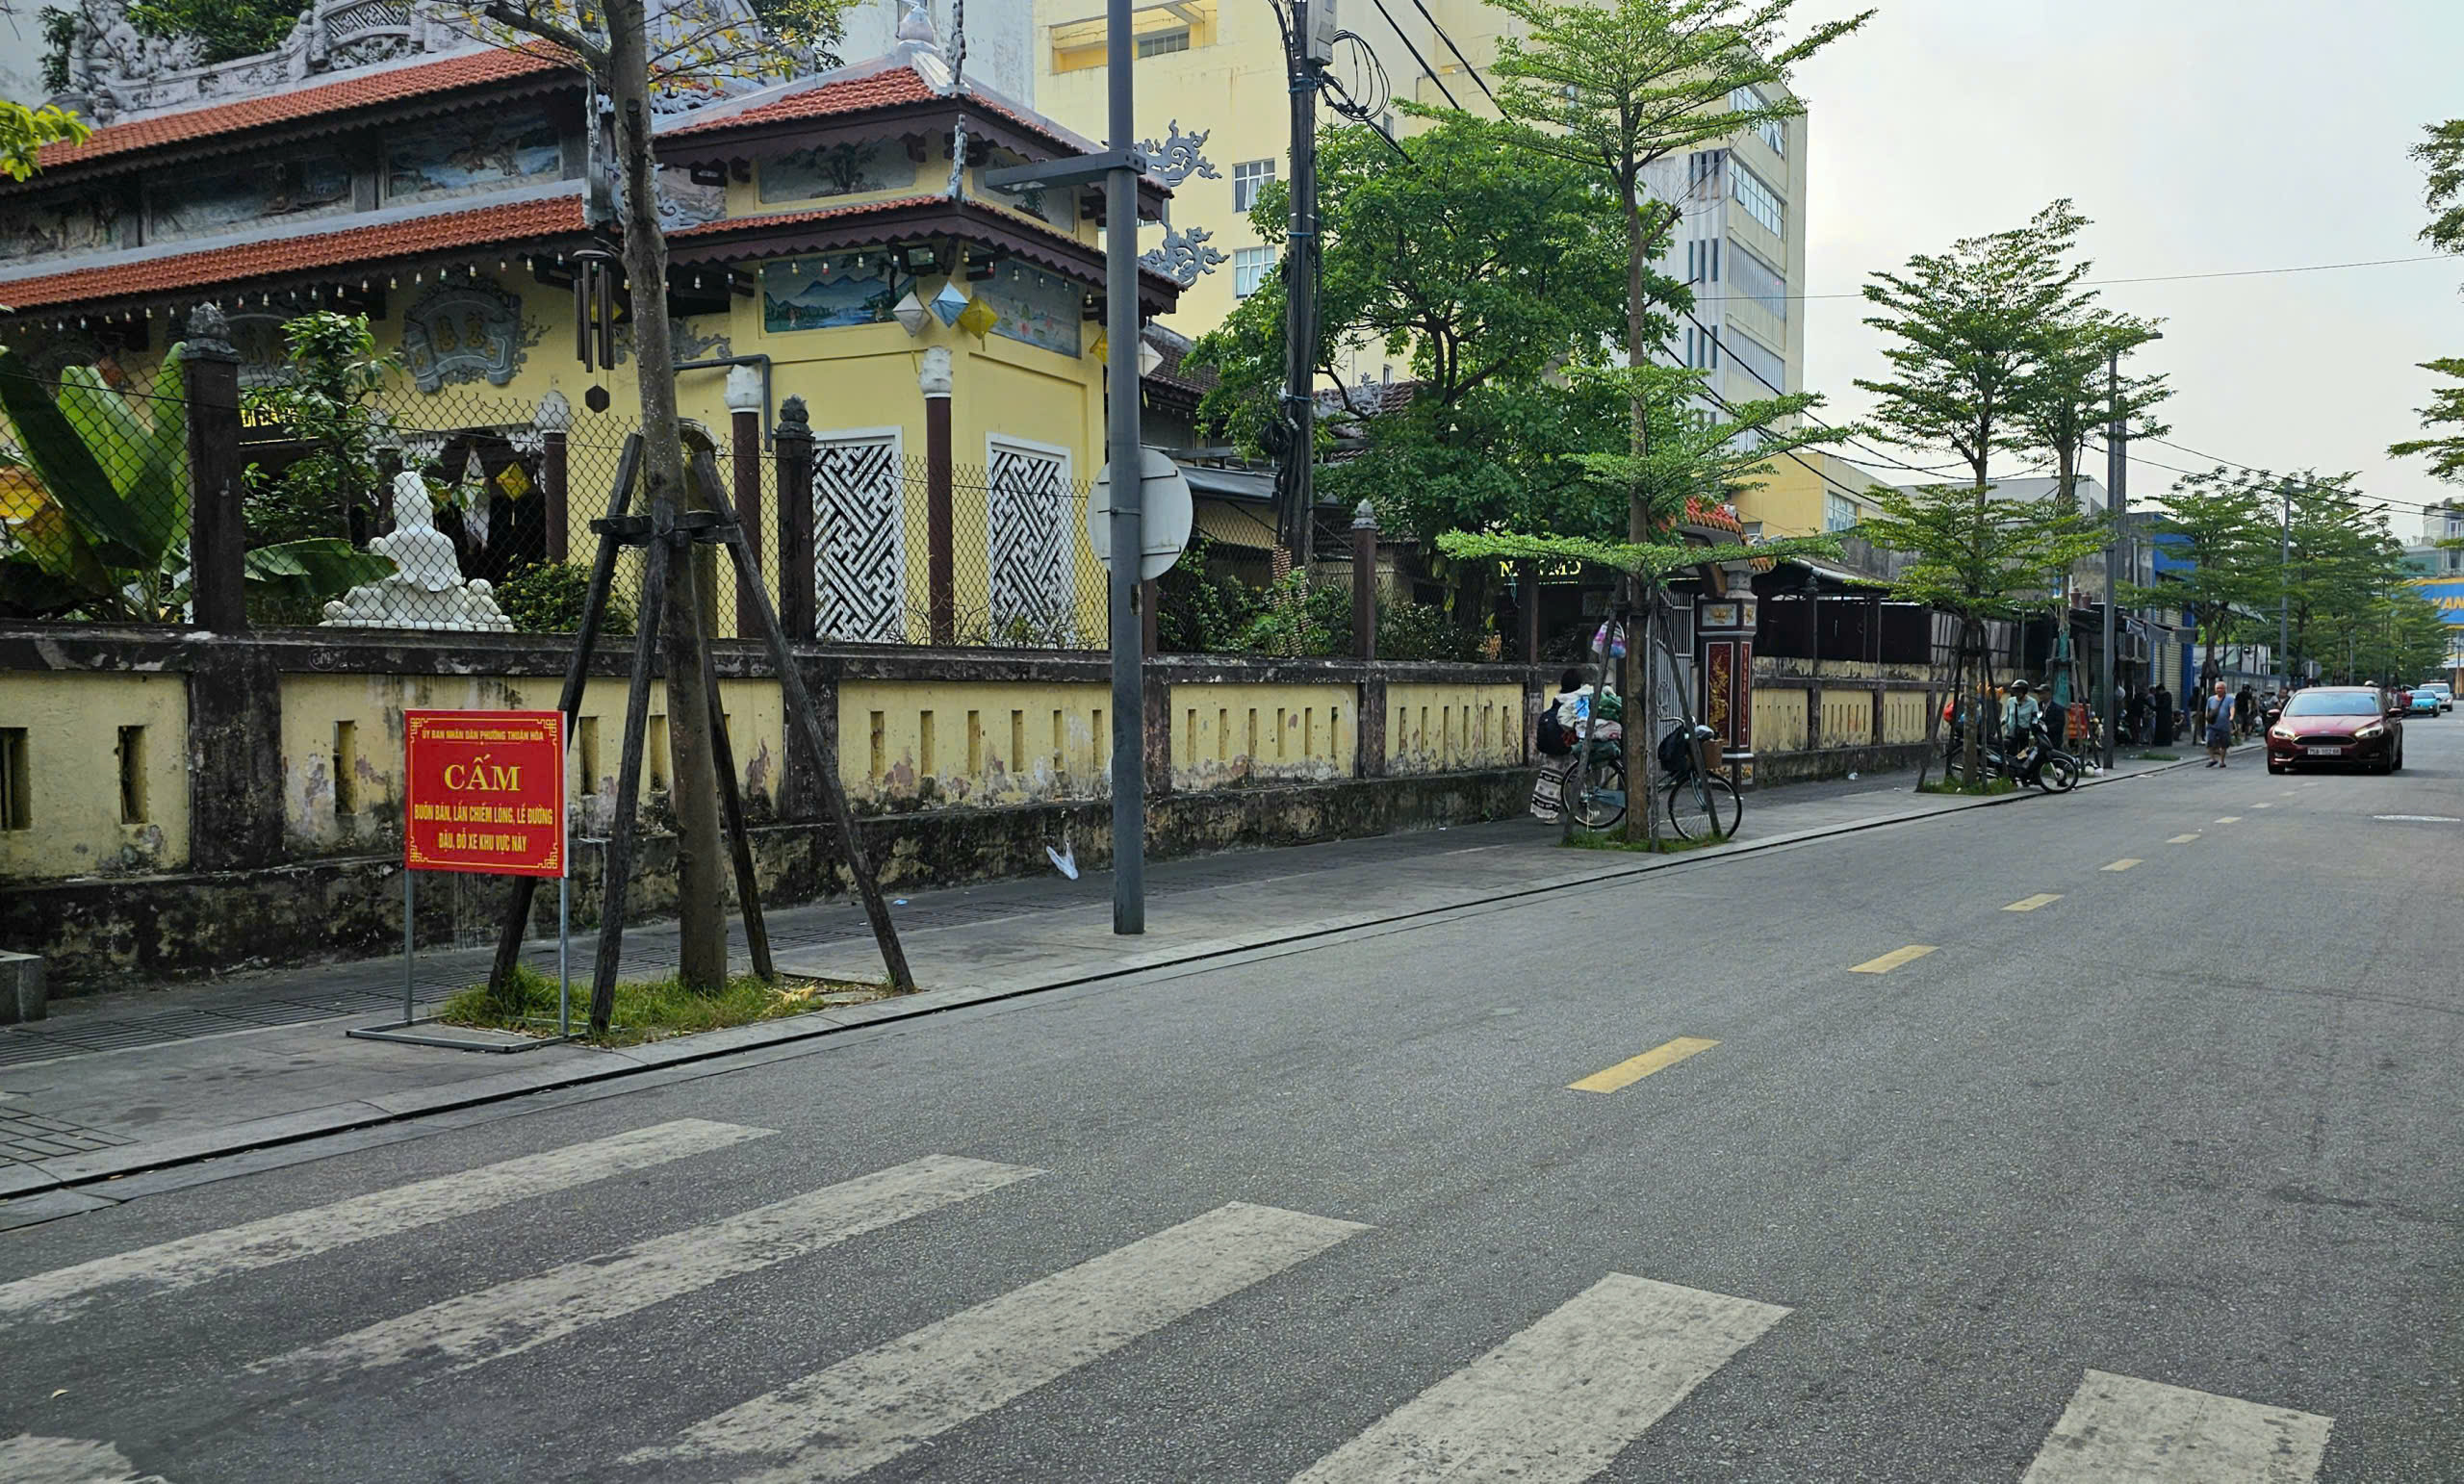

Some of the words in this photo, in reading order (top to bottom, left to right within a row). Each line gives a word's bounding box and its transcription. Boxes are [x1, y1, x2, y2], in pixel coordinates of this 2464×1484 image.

[431, 729, 445, 739] BAN
[444, 754, 522, 791] CẤM
[414, 801, 434, 820] BUÔN
[453, 800, 468, 822] LẤN
[469, 801, 493, 823] CHIẾM
[527, 804, 553, 825] ĐƯỜNG
[468, 833, 478, 850] XE
[479, 833, 495, 851] KHU
[495, 832, 510, 855] VỰC
[511, 832, 527, 853] NÀY
